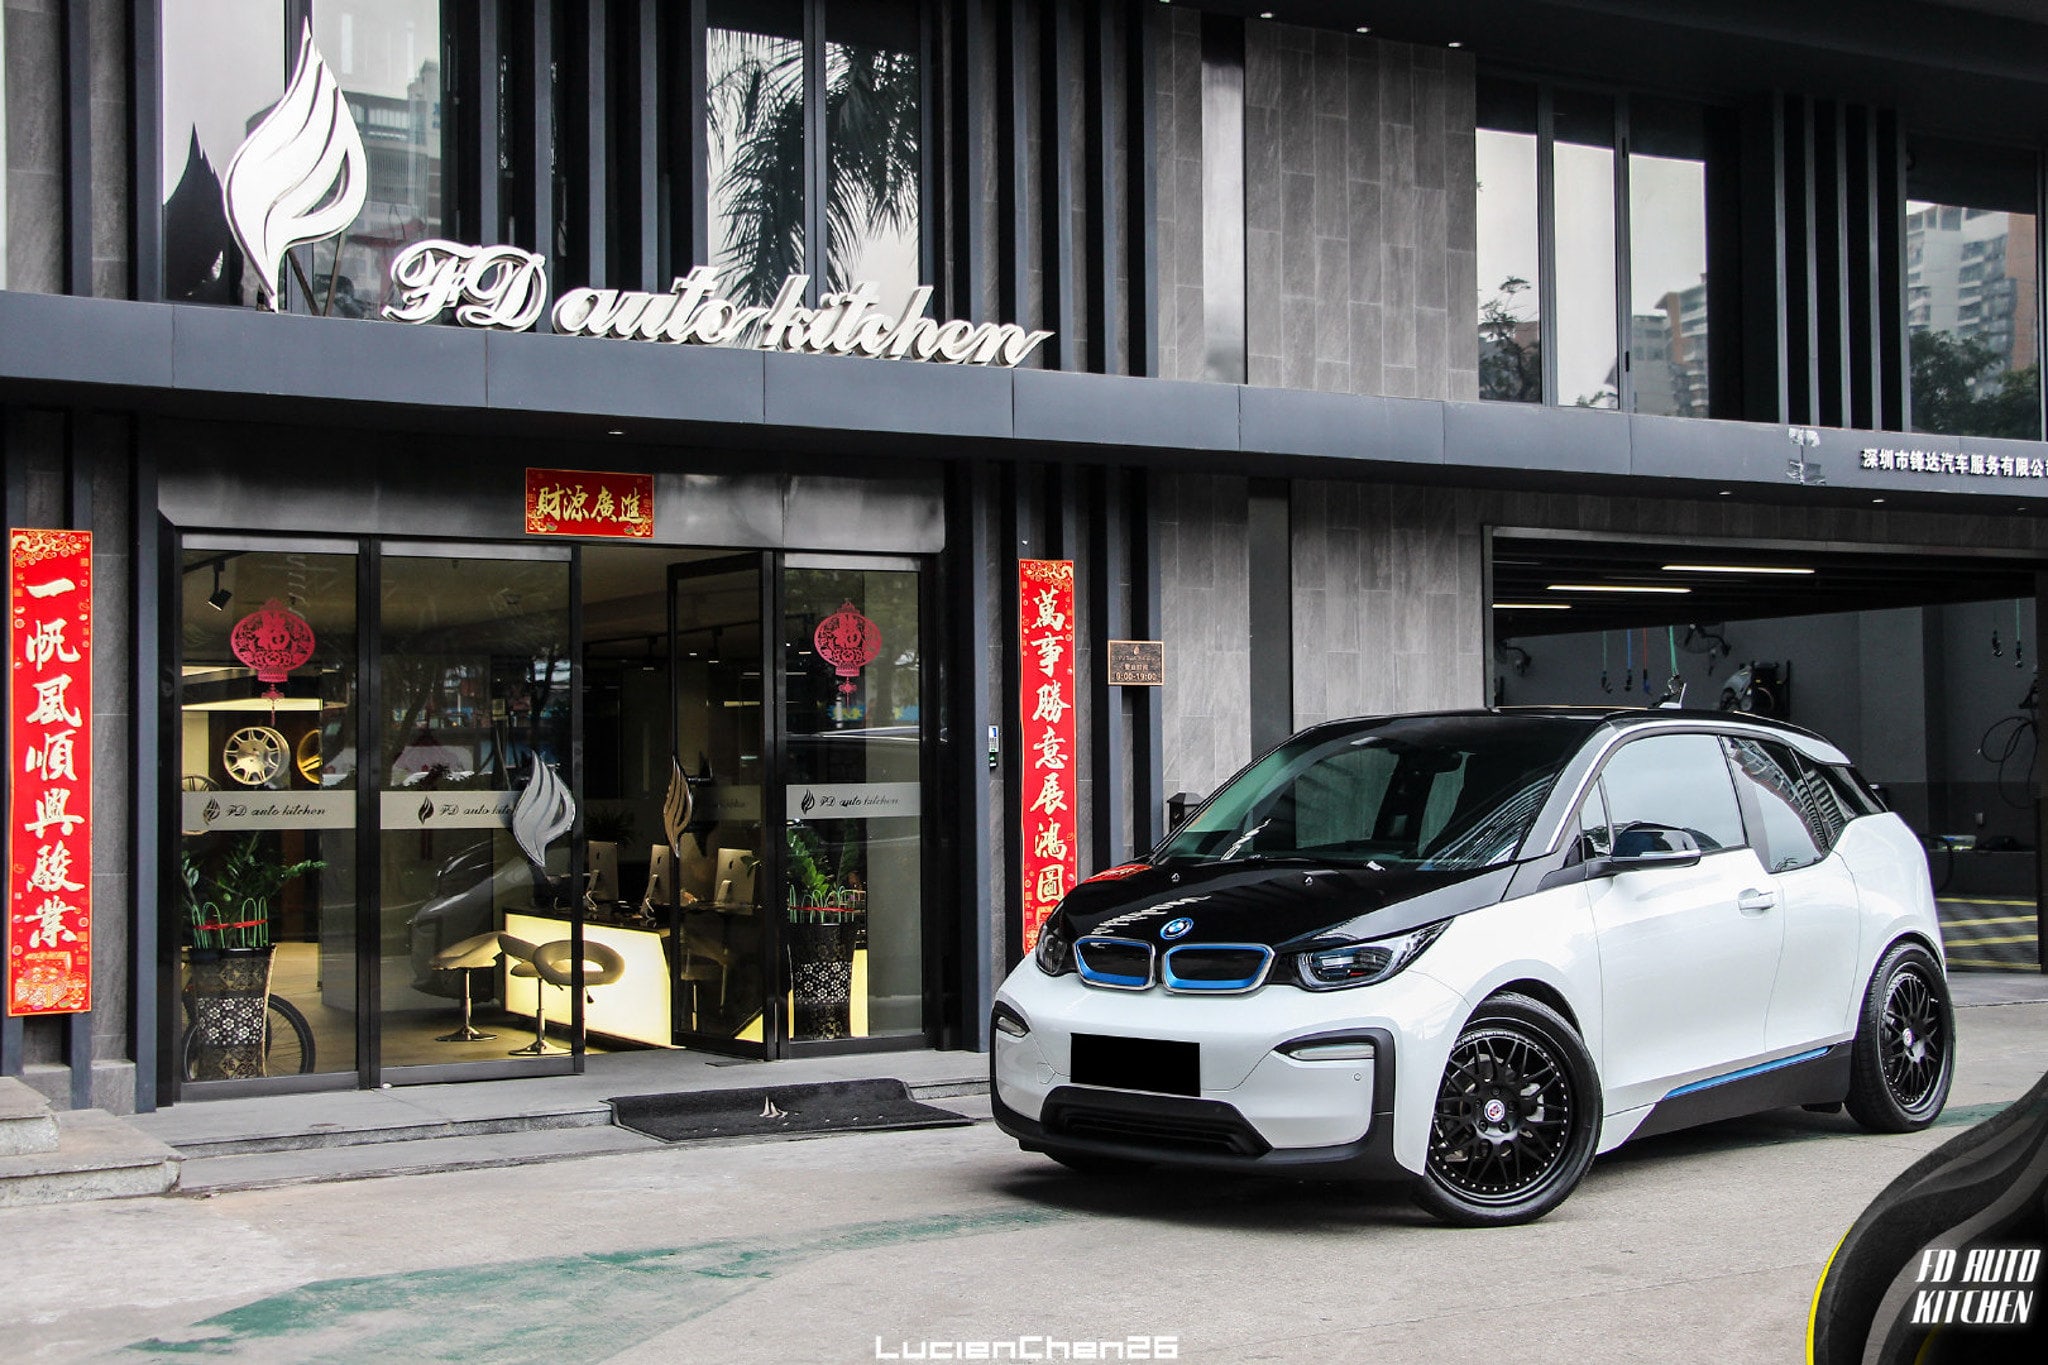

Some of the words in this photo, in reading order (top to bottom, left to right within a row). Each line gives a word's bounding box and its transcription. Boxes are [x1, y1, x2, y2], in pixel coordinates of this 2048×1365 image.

[382, 239, 547, 332] FD
[1863, 448, 2048, 478] 深圳市锋达汽车服务有限公
[839, 795, 862, 808] auto
[250, 804, 280, 817] auto
[282, 803, 326, 817] kitchen
[463, 803, 489, 816] auto
